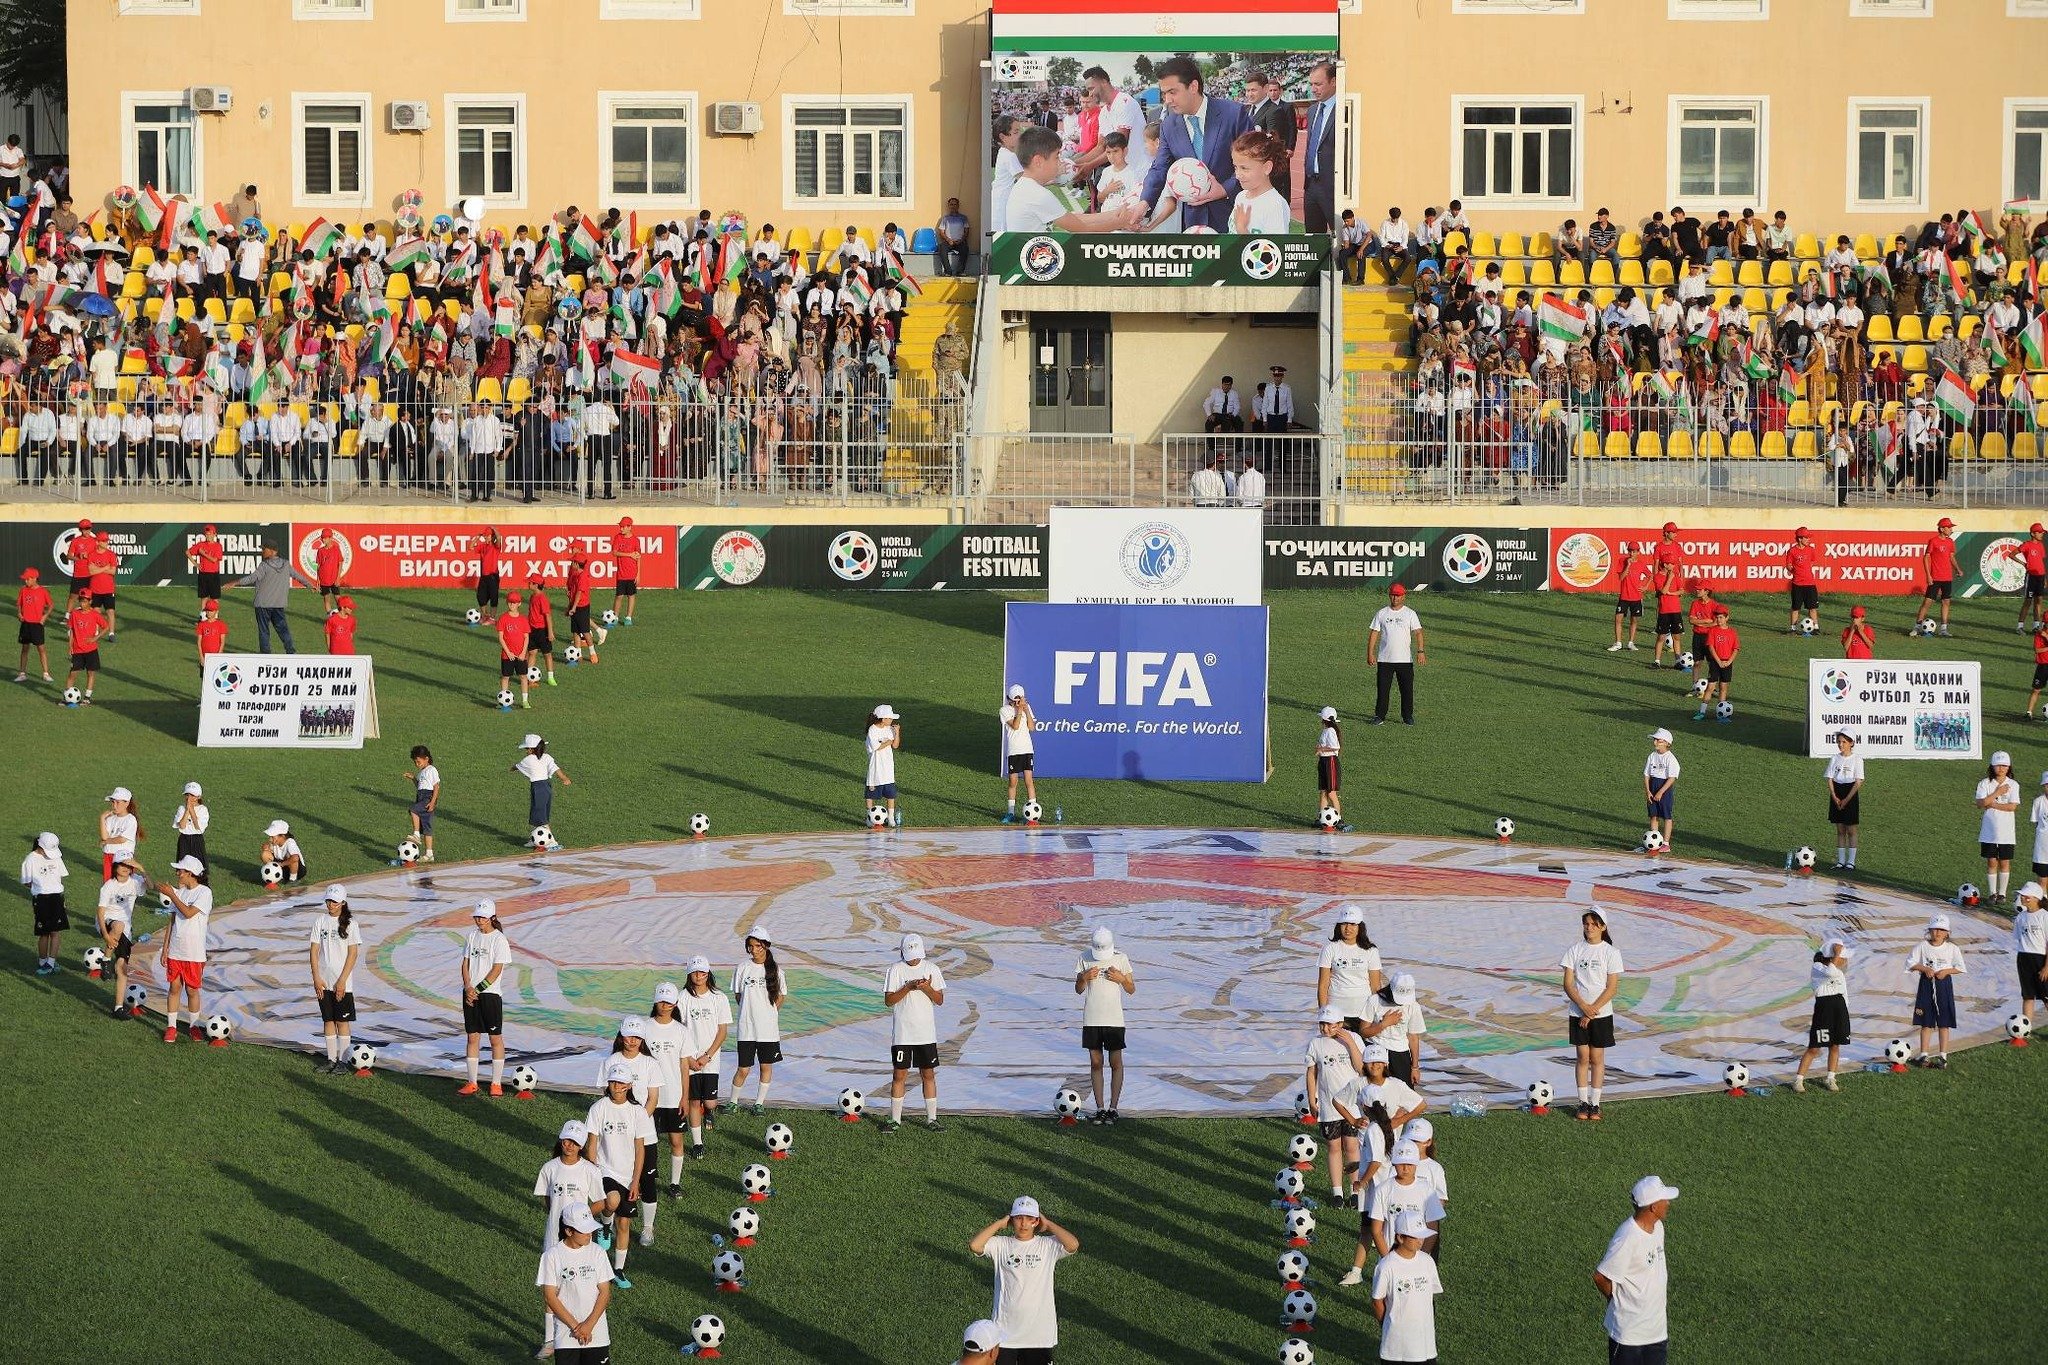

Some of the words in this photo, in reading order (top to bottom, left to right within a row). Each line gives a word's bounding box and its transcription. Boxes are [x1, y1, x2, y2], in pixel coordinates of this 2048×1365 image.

[1080, 244, 1221, 260] ТОҶИКИСТОН
[1284, 244, 1309, 252] WORLD
[1284, 252, 1319, 261] FOOTBALL
[1107, 263, 1136, 278] БА
[1139, 263, 1192, 278] ПЕШ!
[1284, 261, 1298, 270] DAY
[360, 535, 537, 555] ФЕДЕРАТЯИ
[881, 537, 911, 547] WORLD
[962, 536, 1041, 554] FOOTBALL
[1495, 540, 1526, 550] WORLD
[881, 547, 923, 558] FOOTBALL
[1264, 540, 1426, 558] ТОҶИКИСТОН
[1495, 551, 1538, 561] FOOTBALL
[400, 559, 513, 579] ВИЛОЯИ
[525, 560, 618, 579] ХАТОН
[881, 559, 898, 569] DAY
[962, 557, 1042, 577] FESTIVAL
[1296, 560, 1329, 576] БА
[1333, 560, 1394, 576] ПЕШ!
[1495, 561, 1512, 571] DAY
[1506, 573, 1522, 581] MAY
[1747, 565, 1831, 580] ВИЛОТИ
[1841, 566, 1914, 581] ХАТЛОН
[249, 684, 299, 696] ФУТБОЛ
[308, 684, 323, 696] 25
[331, 682, 357, 696] МАЙ
[1859, 690, 1911, 703] ФУТБОЛ
[1919, 691, 1935, 703] 25
[1944, 690, 1970, 704] МАЙ
[218, 701, 231, 710] МО
[236, 701, 286, 711] ТАРАФДОРИ
[238, 715, 263, 724] ТАРЗИ
[1034, 719, 1052, 731] or
[1055, 719, 1079, 731] the
[1084, 720, 1130, 733] Game.
[1135, 721, 1158, 733] For
[1163, 721, 1188, 733] the
[1192, 721, 1242, 735] World.
[250, 729, 279, 738] СОЛИМ
[1867, 735, 1903, 745] МИЛЛАТ
[1816, 1029, 1830, 1043] 15
